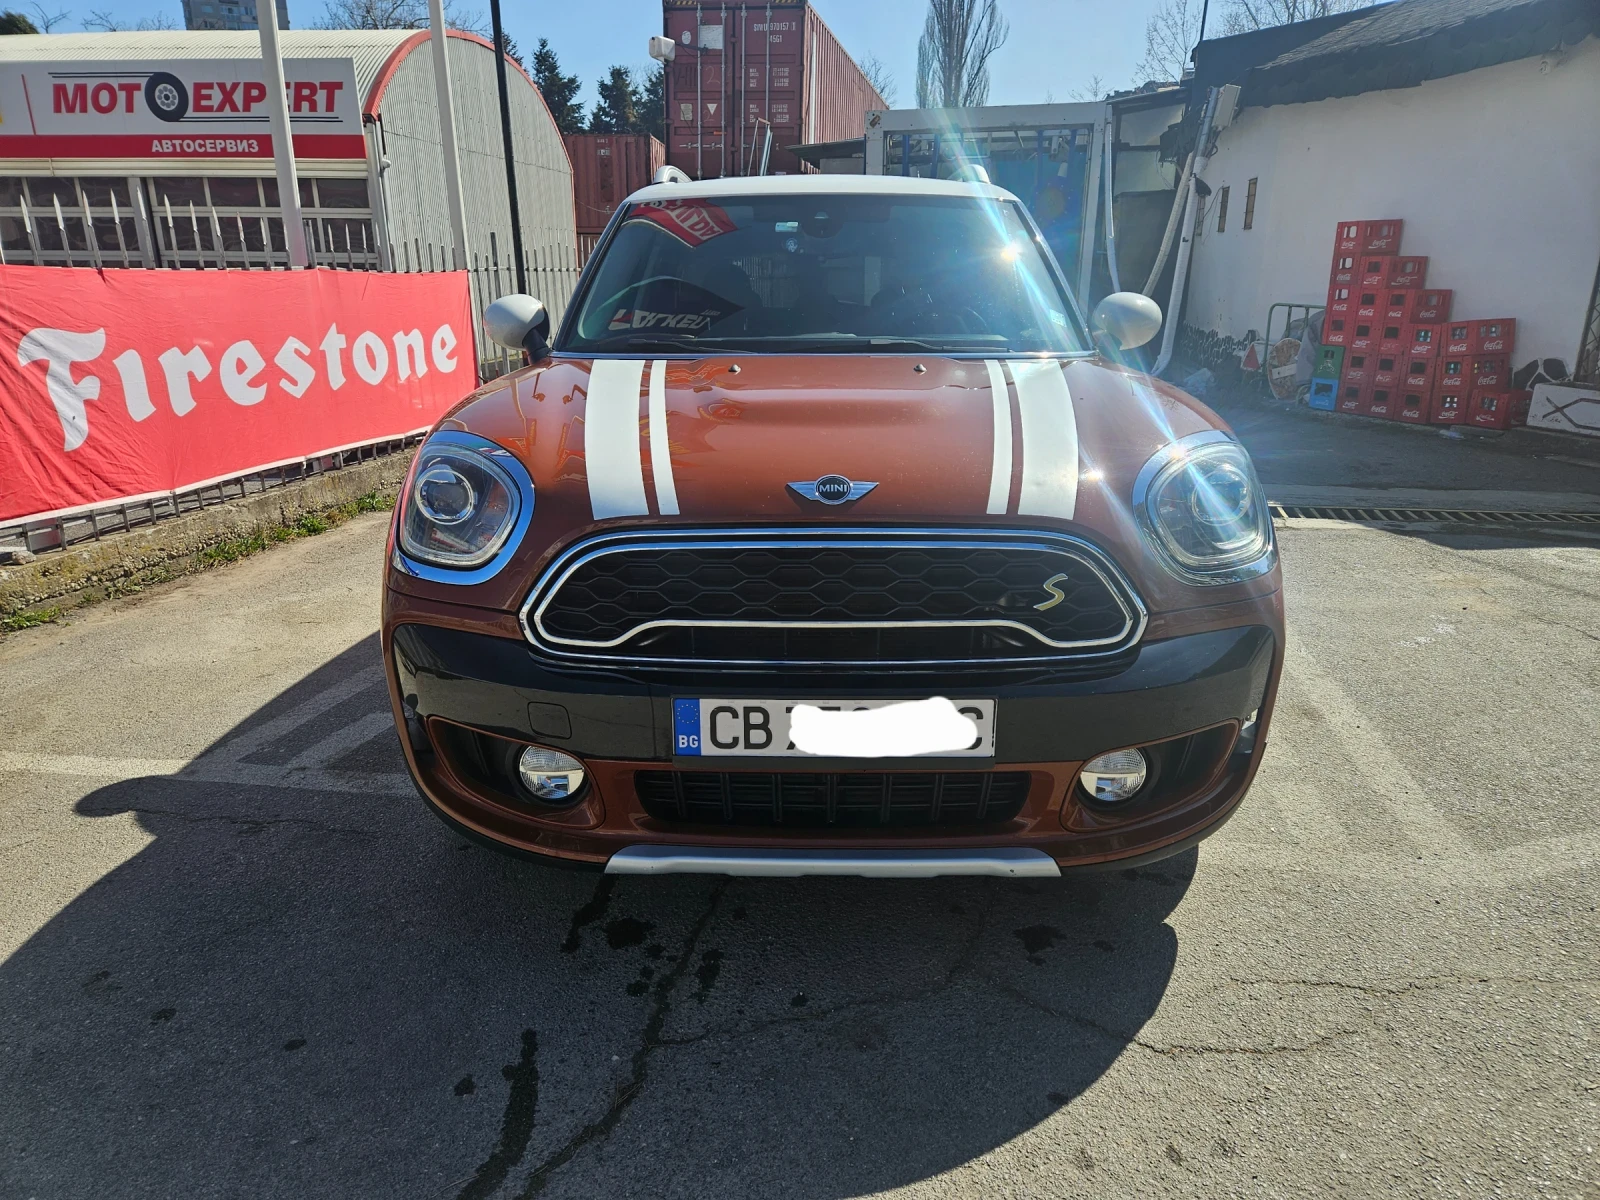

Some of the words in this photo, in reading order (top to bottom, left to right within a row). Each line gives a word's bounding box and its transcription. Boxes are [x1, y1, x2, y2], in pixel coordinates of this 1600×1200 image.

[192, 81, 344, 113] EXPRT
[151, 139, 259, 153] АВТОСЕРВИЗ
[17, 323, 458, 452] Firestone
[819, 484, 848, 493] MINI
[1033, 572, 1069, 611] S
[678, 735, 699, 748] BG
[709, 705, 773, 750] CB
